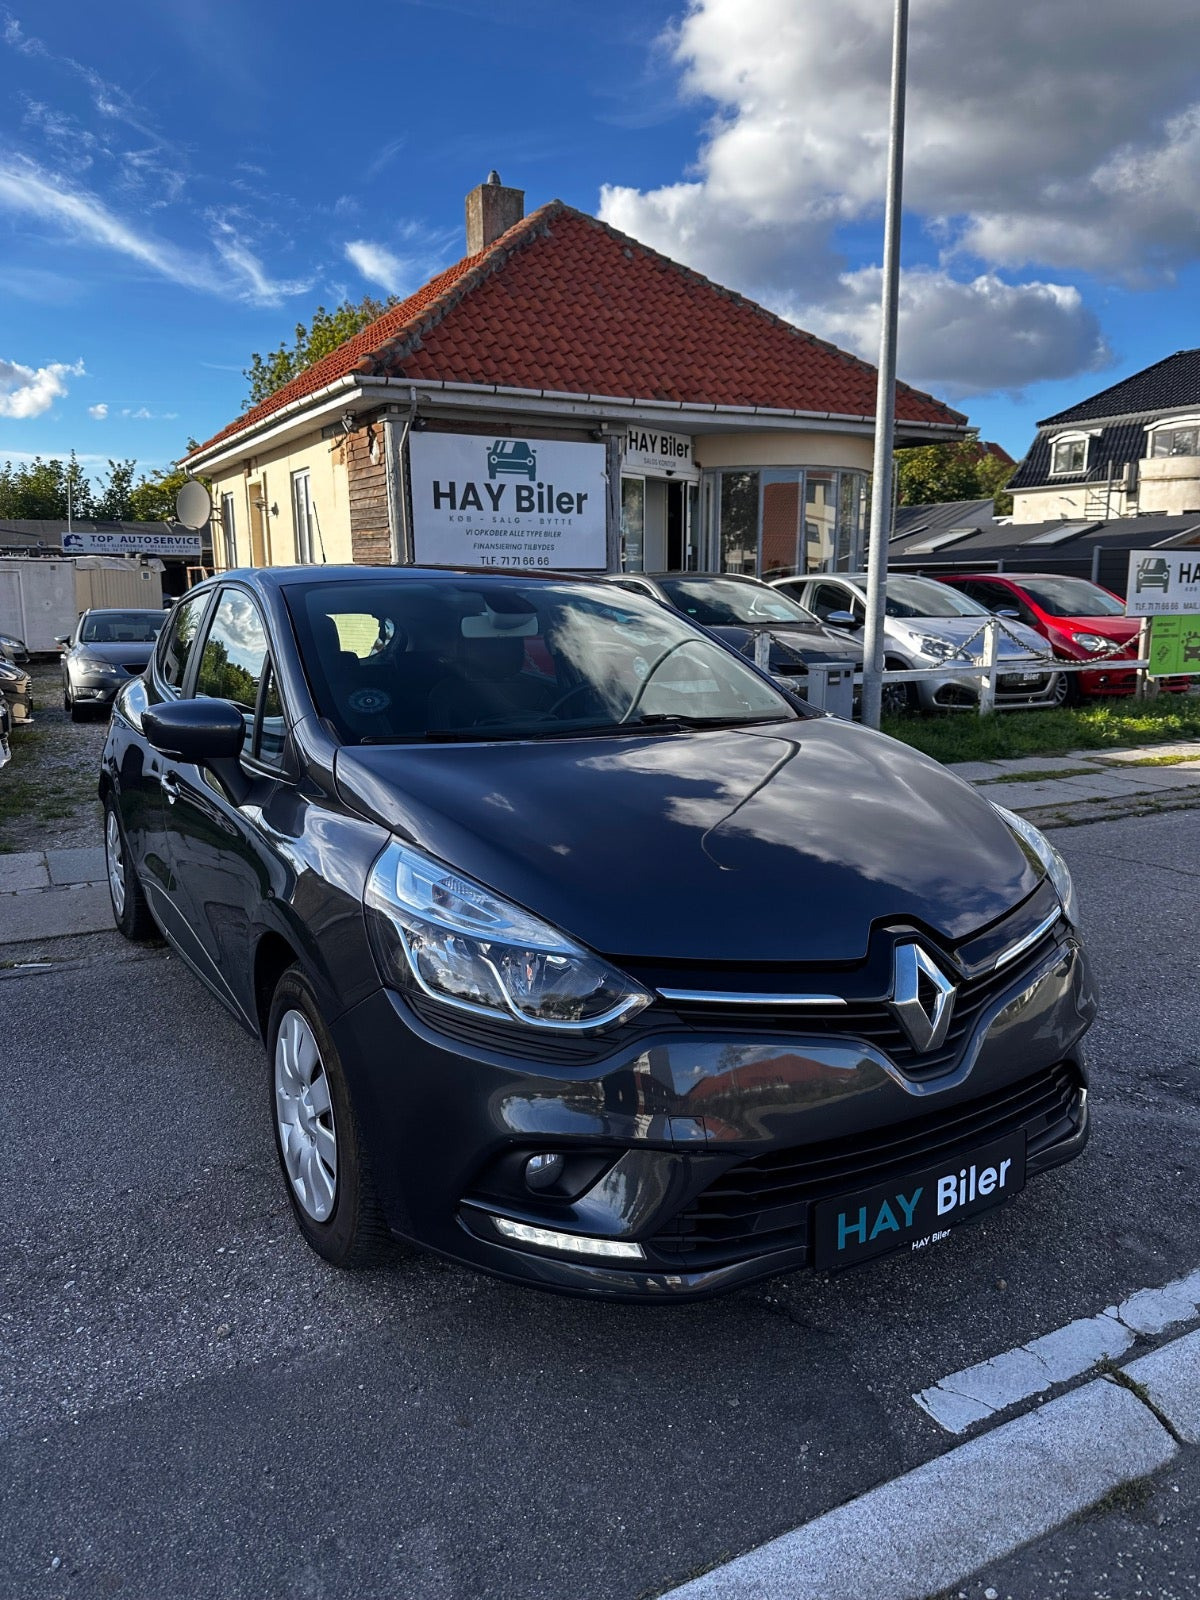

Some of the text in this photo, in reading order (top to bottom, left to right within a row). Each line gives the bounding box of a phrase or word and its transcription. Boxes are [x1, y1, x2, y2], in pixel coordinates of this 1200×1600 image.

[629, 431, 689, 458] HAY Biler
[432, 480, 588, 515] HAY Biler
[492, 516, 521, 524] SALG
[539, 518, 573, 526] BYTTE
[90, 535, 114, 543] TOP
[524, 543, 556, 551] TILBYDES
[480, 556, 499, 565] TLF.
[837, 1158, 1012, 1250] HAY Biler
[911, 1228, 951, 1250] HAY Biler
